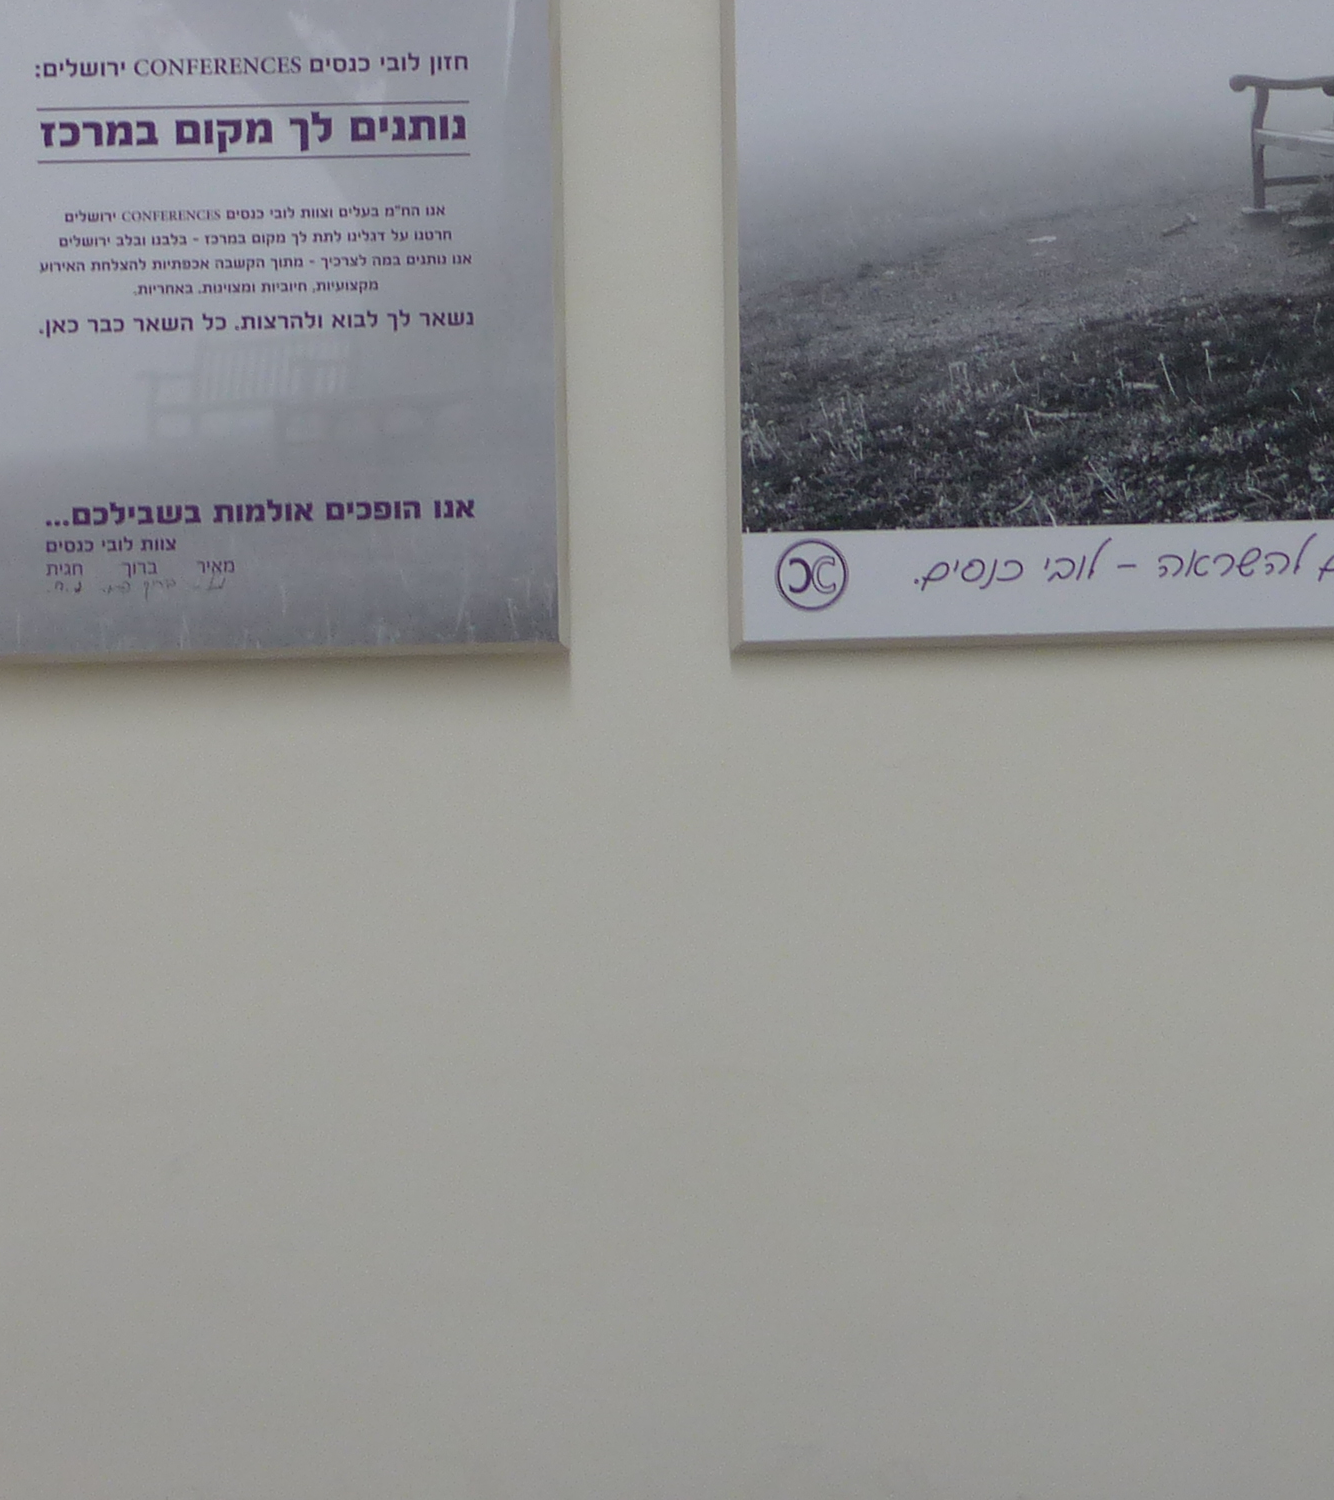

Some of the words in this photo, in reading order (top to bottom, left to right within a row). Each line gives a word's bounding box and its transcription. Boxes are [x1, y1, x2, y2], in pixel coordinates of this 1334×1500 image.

[35, 58, 126, 78] ירושלים:
[133, 55, 302, 77] CONFERENCES
[309, 56, 371, 73] כנסים
[380, 52, 420, 72] לובי
[429, 55, 469, 76] חזון
[40, 120, 159, 148] במרכז
[175, 117, 273, 154] מקום
[289, 111, 333, 152] לך
[350, 114, 467, 142] נותנים
[64, 211, 116, 223] ירושלים
[121, 209, 221, 223] CONFERENCES
[225, 208, 265, 220] כנסים
[269, 206, 295, 220] לובי
[300, 208, 334, 219] וצוות
[338, 204, 380, 218] בעלים
[424, 204, 446, 217] אנו
[59, 235, 111, 248] ירושלים
[116, 234, 147, 247] ובלב
[151, 233, 188, 246] בלבנו
[204, 233, 247, 246] במרכז
[251, 233, 287, 247] מקום
[291, 231, 307, 246] לך
[312, 230, 342, 243] לתת
[347, 230, 386, 243] דגלינו
[390, 229, 409, 242] על
[414, 230, 453, 242] חרטנו
[90, 258, 147, 272] להצלחת
[151, 258, 210, 271] אכפתיות
[214, 257, 266, 272] הקשבה
[270, 256, 304, 271] מתוך
[320, 254, 367, 270] לצרכיך
[372, 255, 402, 267] במה
[406, 255, 447, 266] נותנים
[452, 253, 473, 265] אנו
[39, 261, 86, 274] האירוע
[261, 281, 308, 294] חיוביות
[87, 318, 125, 333] כבר
[133, 316, 194, 332] השאר
[202, 312, 227, 331] כל
[234, 311, 323, 332] ולהרצות.
[331, 309, 378, 328] לבוא
[387, 309, 411, 332] לך
[419, 311, 475, 327] נשאר
[38, 318, 79, 338] כאן.
[45, 501, 201, 527] בשבילכם...
[212, 497, 314, 524] אולמות
[325, 498, 422, 522] הופכים
[432, 496, 476, 520] אנו
[45, 539, 95, 553] כנסים
[101, 536, 134, 553] לובי
[140, 537, 177, 551] צוות
[1044, 537, 1113, 582] לובי
[1157, 532, 1318, 578] להשראה
[45, 562, 84, 577] חגית
[121, 561, 158, 579] ברוך
[195, 559, 236, 574] מאיר
[913, 558, 1025, 592] כנסים.
